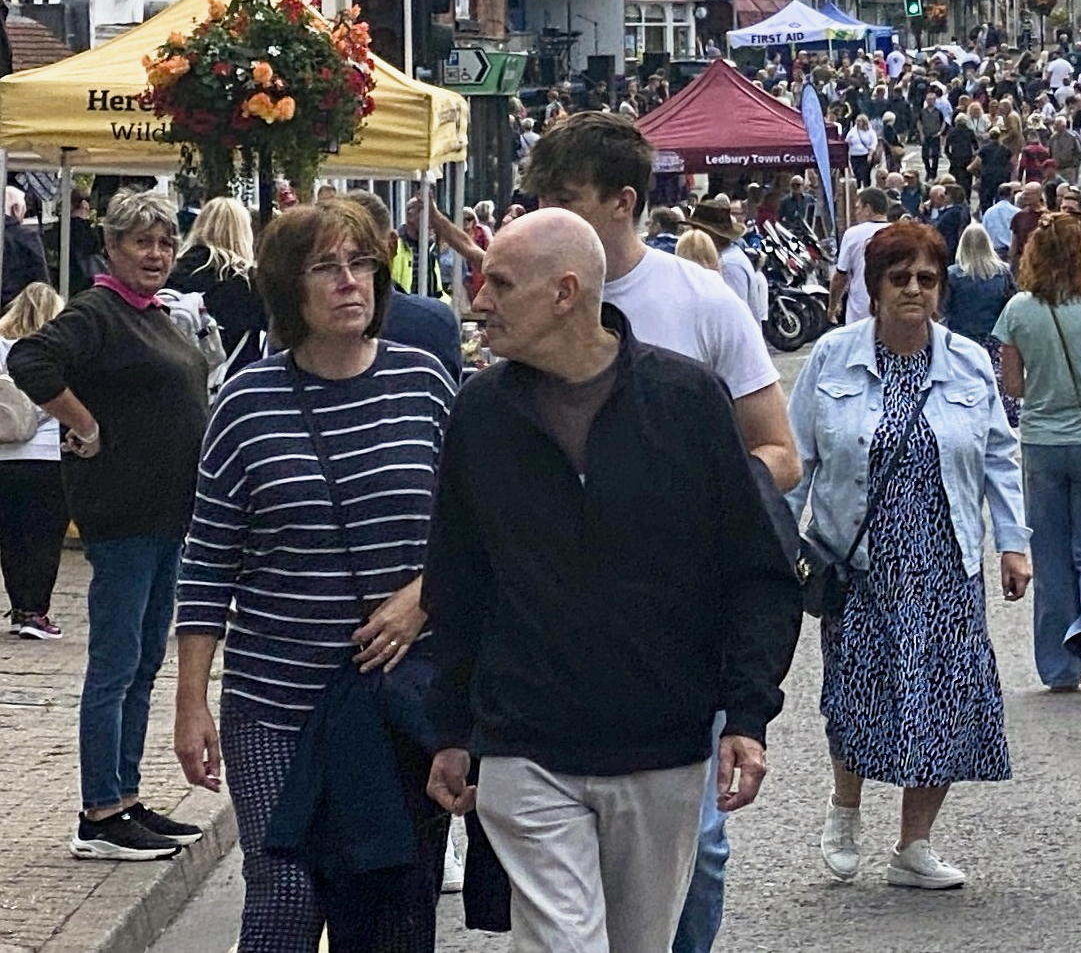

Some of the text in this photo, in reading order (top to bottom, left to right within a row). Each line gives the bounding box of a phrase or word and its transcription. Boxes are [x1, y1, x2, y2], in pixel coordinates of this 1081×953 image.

[751, 32, 805, 44] FIRST AID
[705, 153, 816, 165] Ledbury Town Counc
